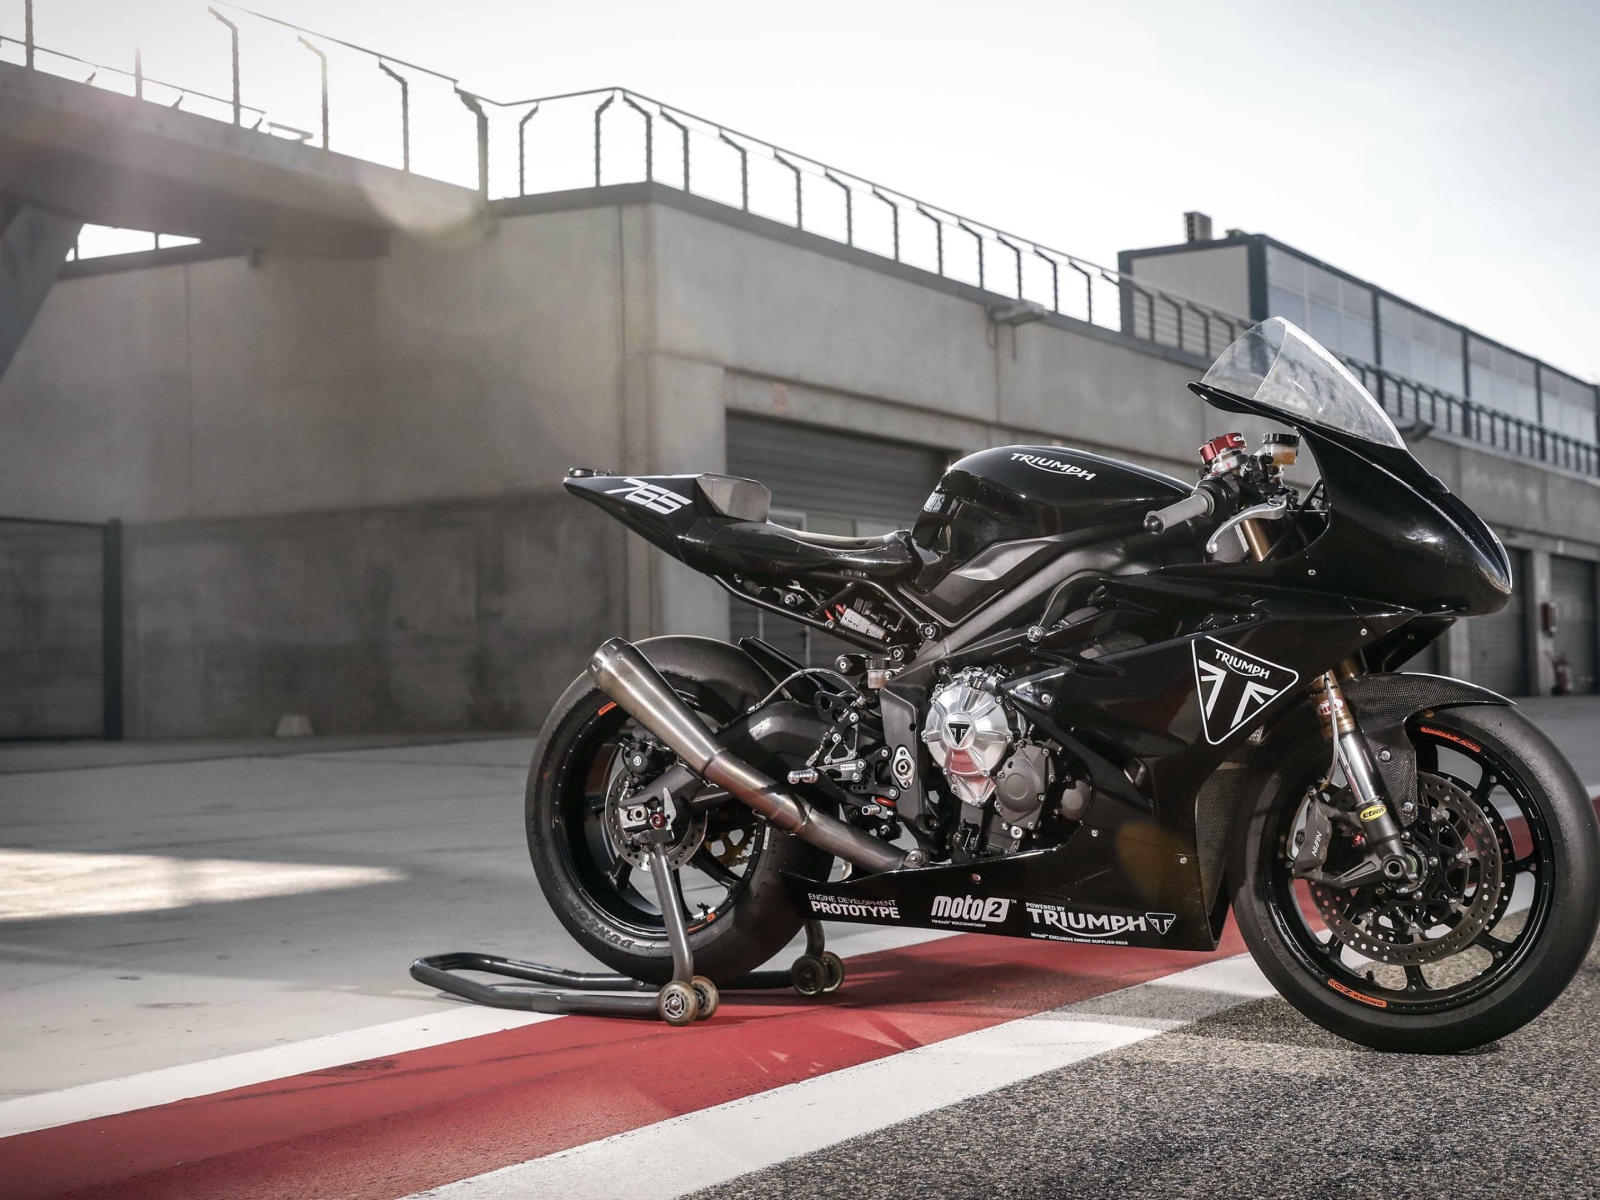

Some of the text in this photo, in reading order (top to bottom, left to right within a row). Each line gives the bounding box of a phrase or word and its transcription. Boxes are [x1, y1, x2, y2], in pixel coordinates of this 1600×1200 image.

[1010, 453, 1097, 481] TRIUMPH
[604, 477, 693, 515] 765
[1215, 648, 1271, 680] TRIUMPH
[808, 893, 896, 907] ENGINE DEVELOPMENT
[810, 901, 901, 919] PROTOTYPE
[1025, 902, 1056, 911] POWERED
[1026, 908, 1147, 937] TRIUMPH
[1353, 994, 1383, 1007] RACING
